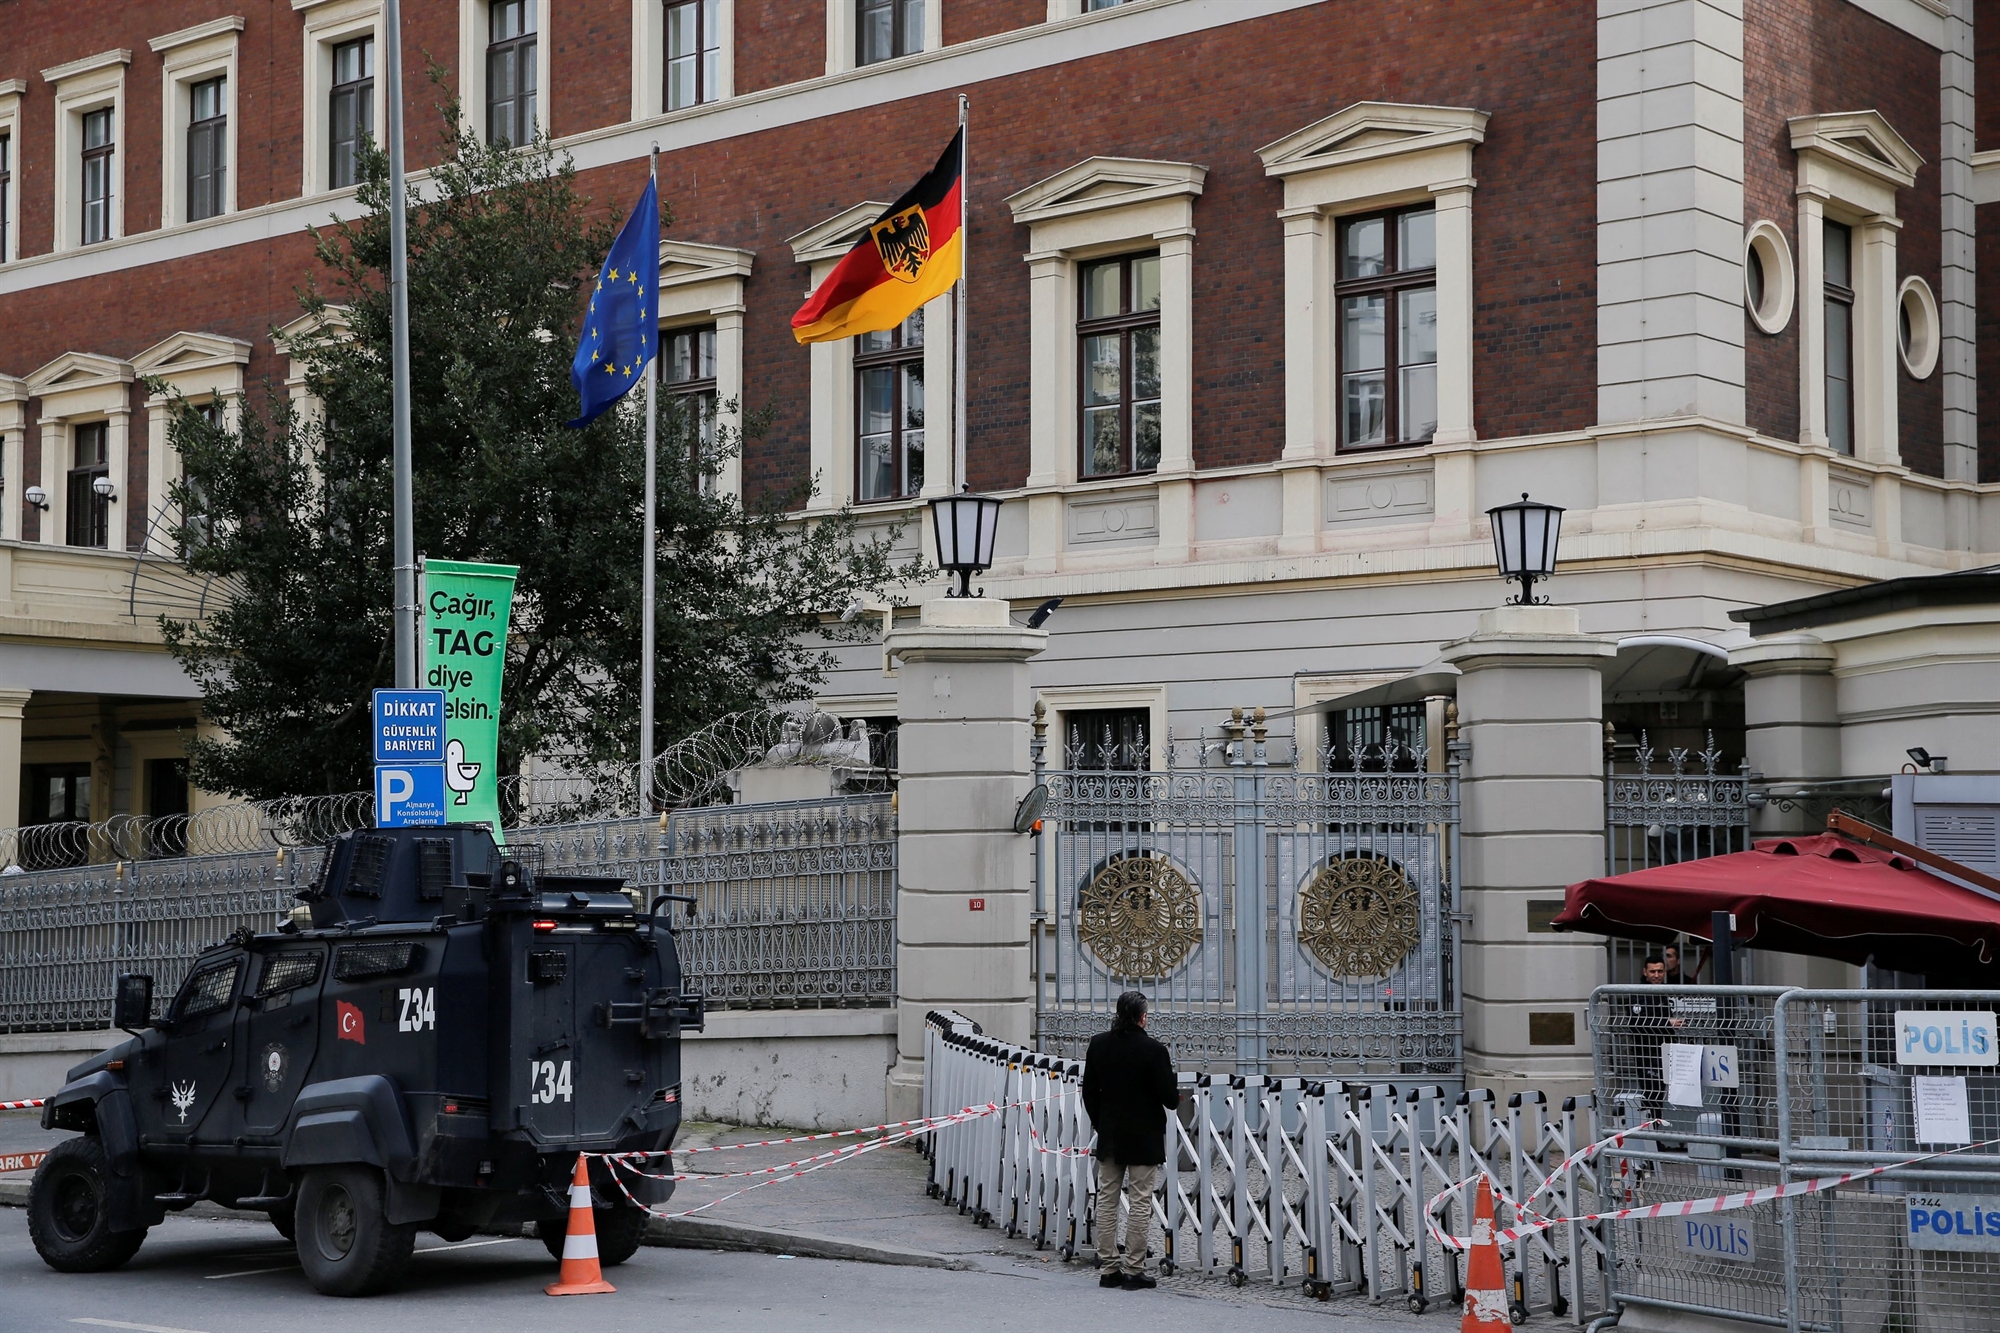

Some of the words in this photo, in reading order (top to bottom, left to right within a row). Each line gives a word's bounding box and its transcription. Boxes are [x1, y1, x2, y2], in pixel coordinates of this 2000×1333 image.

[429, 591, 495, 621] Çağır,
[432, 628, 494, 656] TAG
[428, 665, 473, 693] diye
[384, 699, 436, 716] DİKKAT
[445, 697, 494, 720] elsin.
[383, 724, 437, 737] GÜVENLİK
[384, 738, 435, 751] BARİYERİ
[381, 770, 414, 822] P
[397, 810, 443, 818] Konsolosluğu
[403, 818, 438, 826] Araçlarına
[973, 901, 981, 909] 10
[399, 987, 435, 1031] Z34
[1905, 1020, 1989, 1054] POLİS
[0, 1156, 24, 1169] ARK
[1910, 1198, 1941, 1207] B-244
[1910, 1205, 2000, 1237] POLİS
[1685, 1220, 1749, 1256] POLİS
